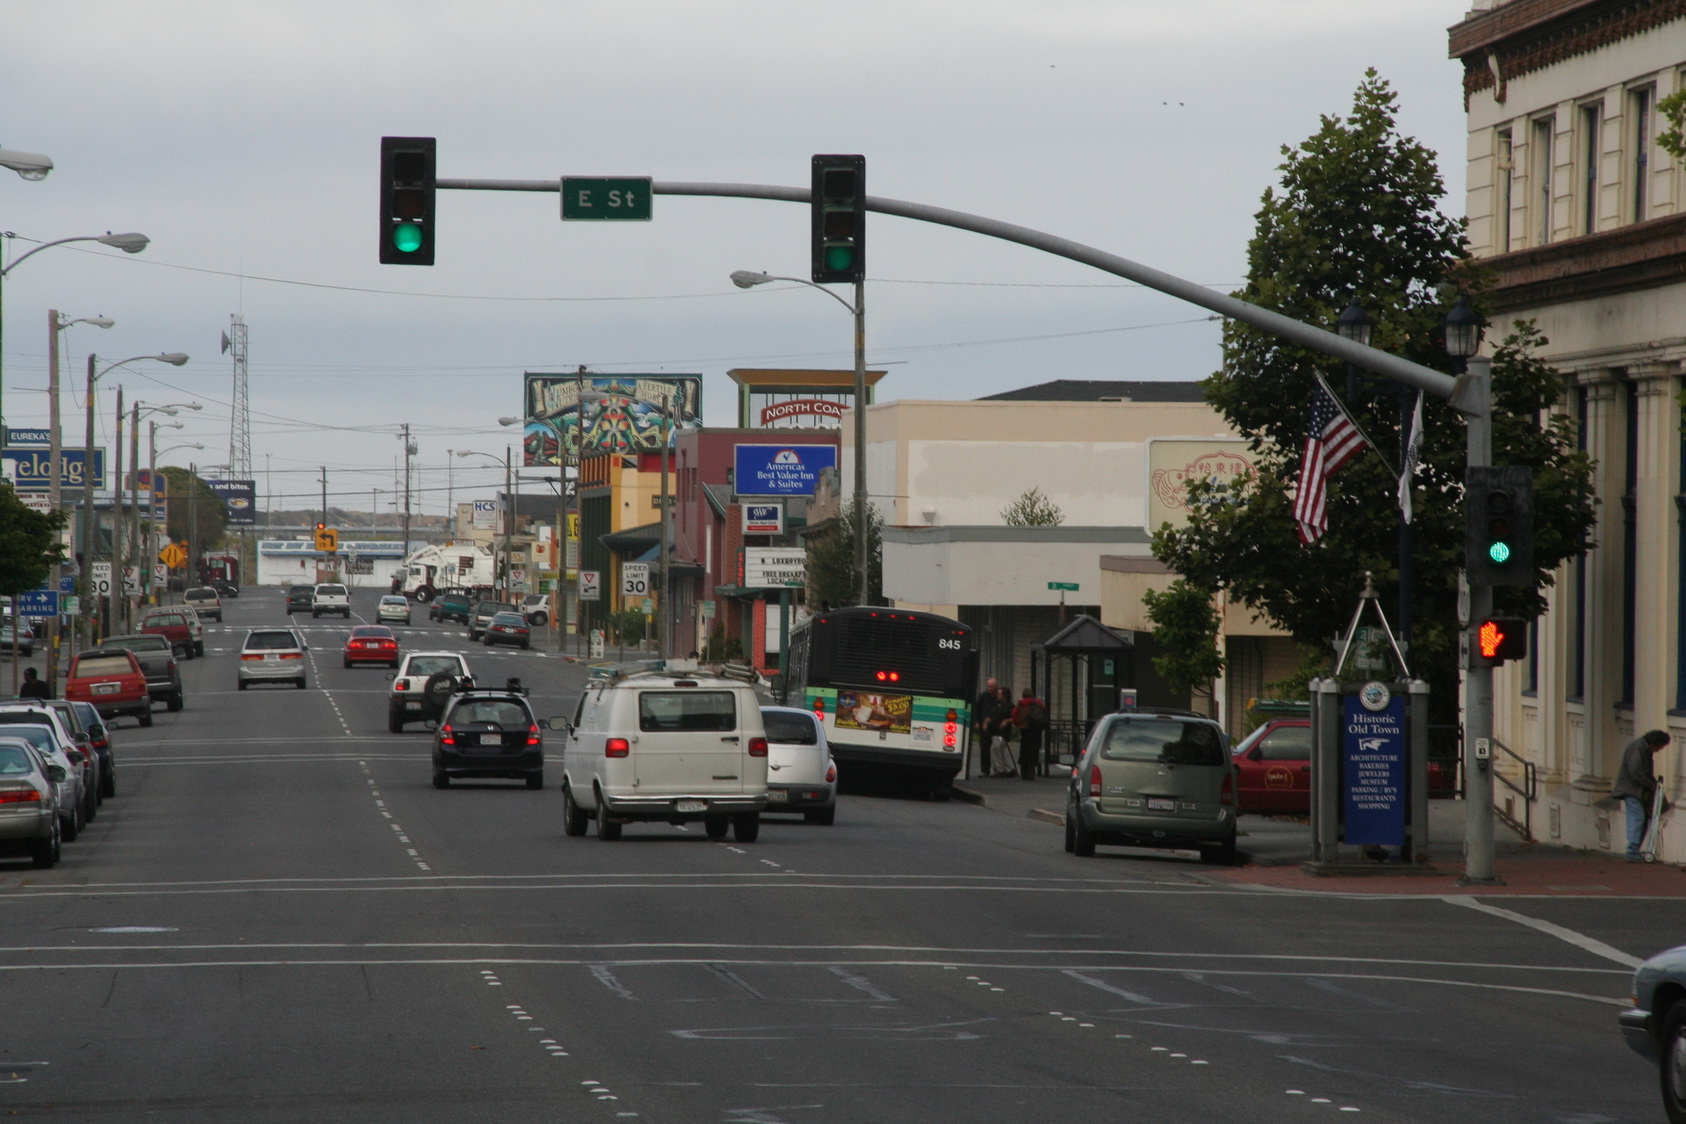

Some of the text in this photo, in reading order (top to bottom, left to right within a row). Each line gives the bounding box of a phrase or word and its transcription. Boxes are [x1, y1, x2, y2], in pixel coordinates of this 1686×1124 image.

[579, 190, 634, 207] E St
[766, 402, 841, 419] NORTH COA
[11, 432, 51, 440] EUREKA'S
[766, 462, 805, 471] Americas
[757, 471, 814, 480] Best Value Inn
[475, 502, 495, 511] HCS
[626, 580, 646, 592] 30
[939, 639, 961, 650] 845
[1353, 714, 1396, 724] Historic
[1348, 724, 1400, 734] Old Town
